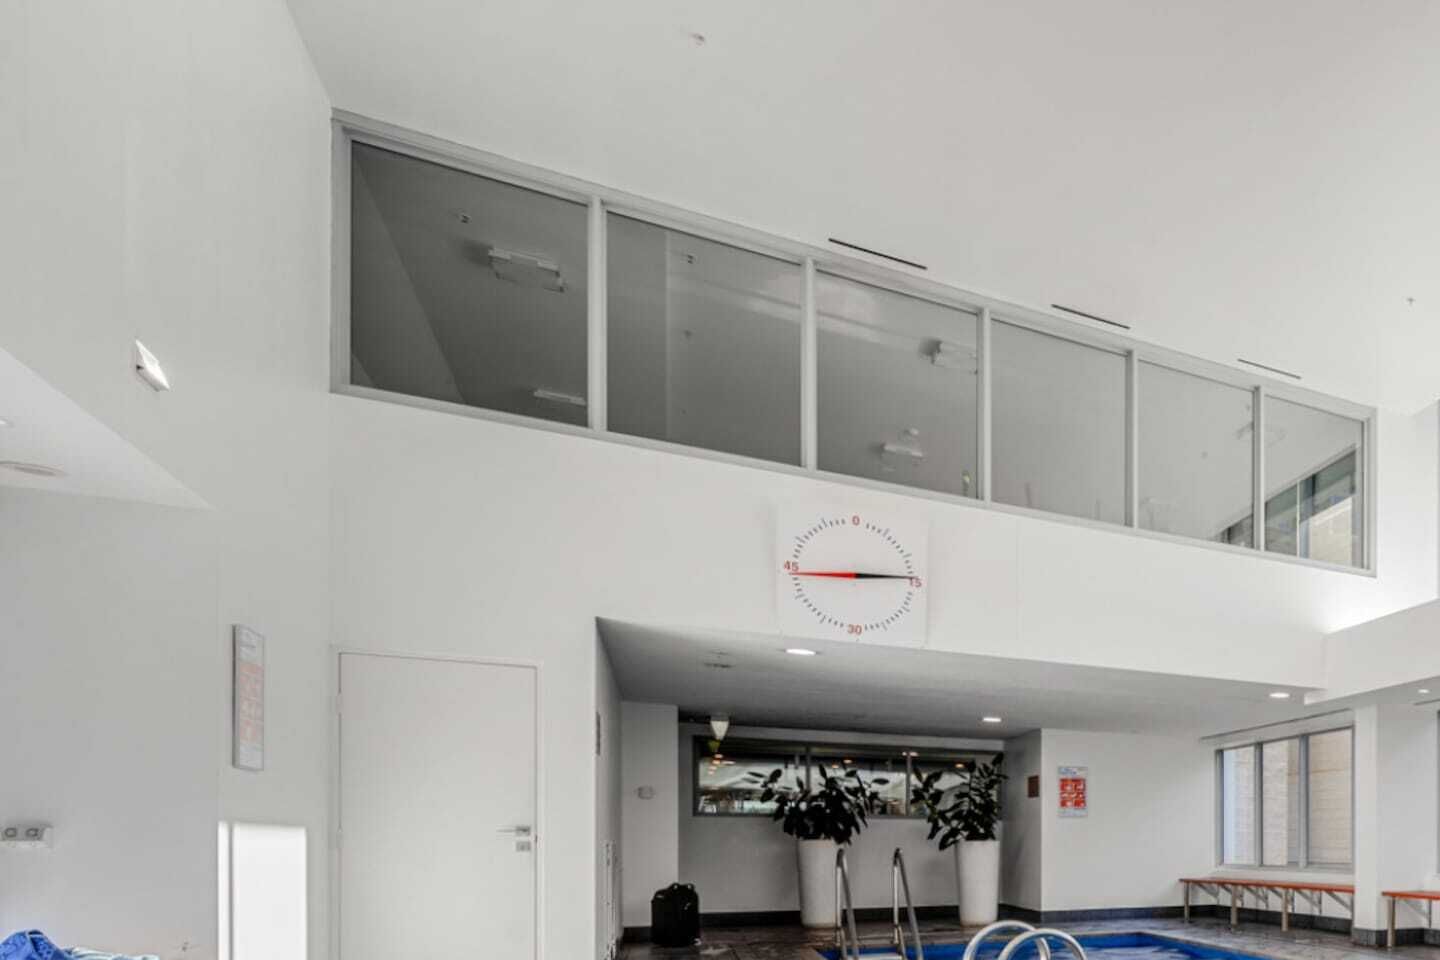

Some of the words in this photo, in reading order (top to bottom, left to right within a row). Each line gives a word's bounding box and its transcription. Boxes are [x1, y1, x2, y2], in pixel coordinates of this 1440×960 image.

[852, 515, 860, 526] 0
[784, 560, 799, 571] 45
[847, 624, 862, 635] 30
